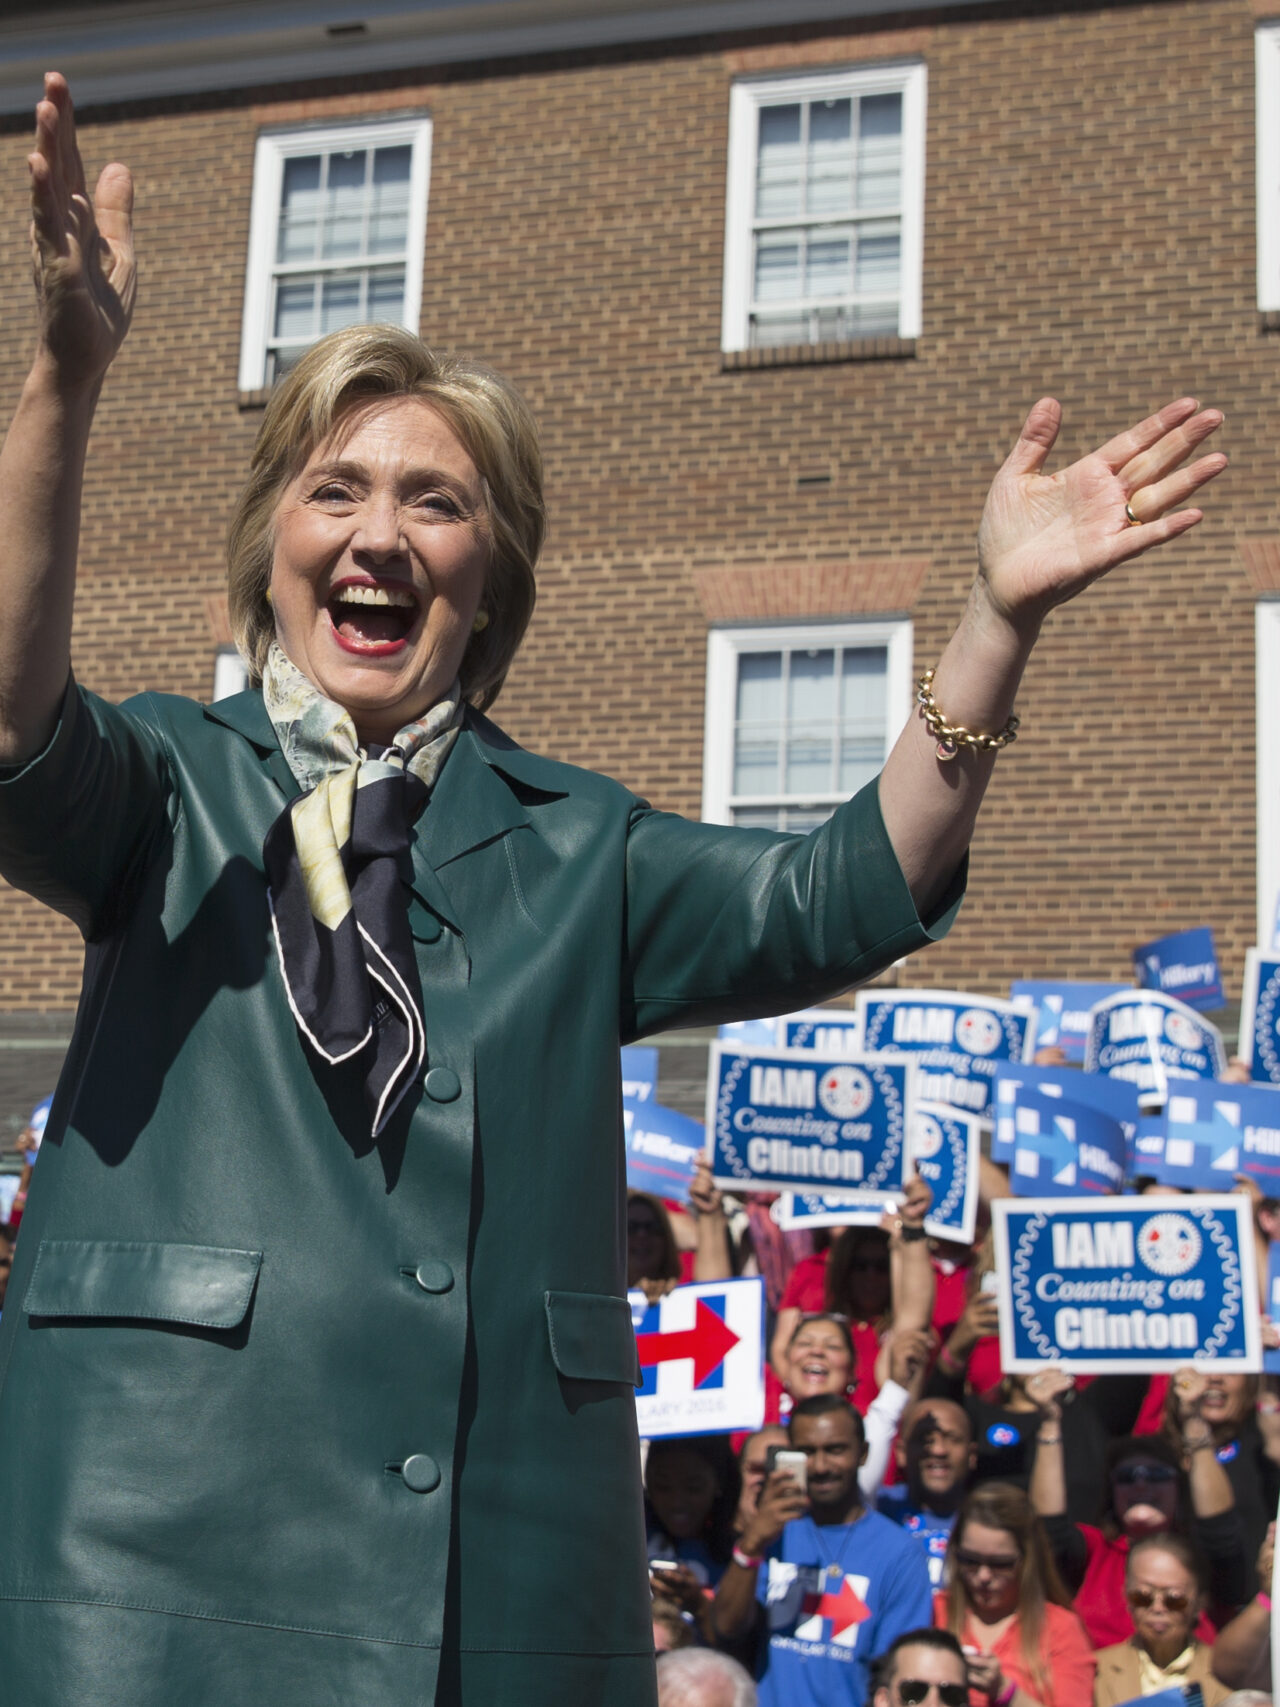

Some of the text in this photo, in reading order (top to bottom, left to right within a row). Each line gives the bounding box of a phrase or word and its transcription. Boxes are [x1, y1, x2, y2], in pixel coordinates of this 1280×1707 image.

[893, 1007, 955, 1044] IAM
[1060, 1010, 1094, 1032] Hill
[749, 1064, 817, 1109] IAM
[733, 1107, 872, 1145] Counting on
[1243, 1125, 1280, 1156] Hill
[747, 1137, 865, 1181] Clinton
[1051, 1221, 1135, 1269] IAM
[1035, 1272, 1206, 1309] Counting on
[1054, 1307, 1199, 1350] Clinton
